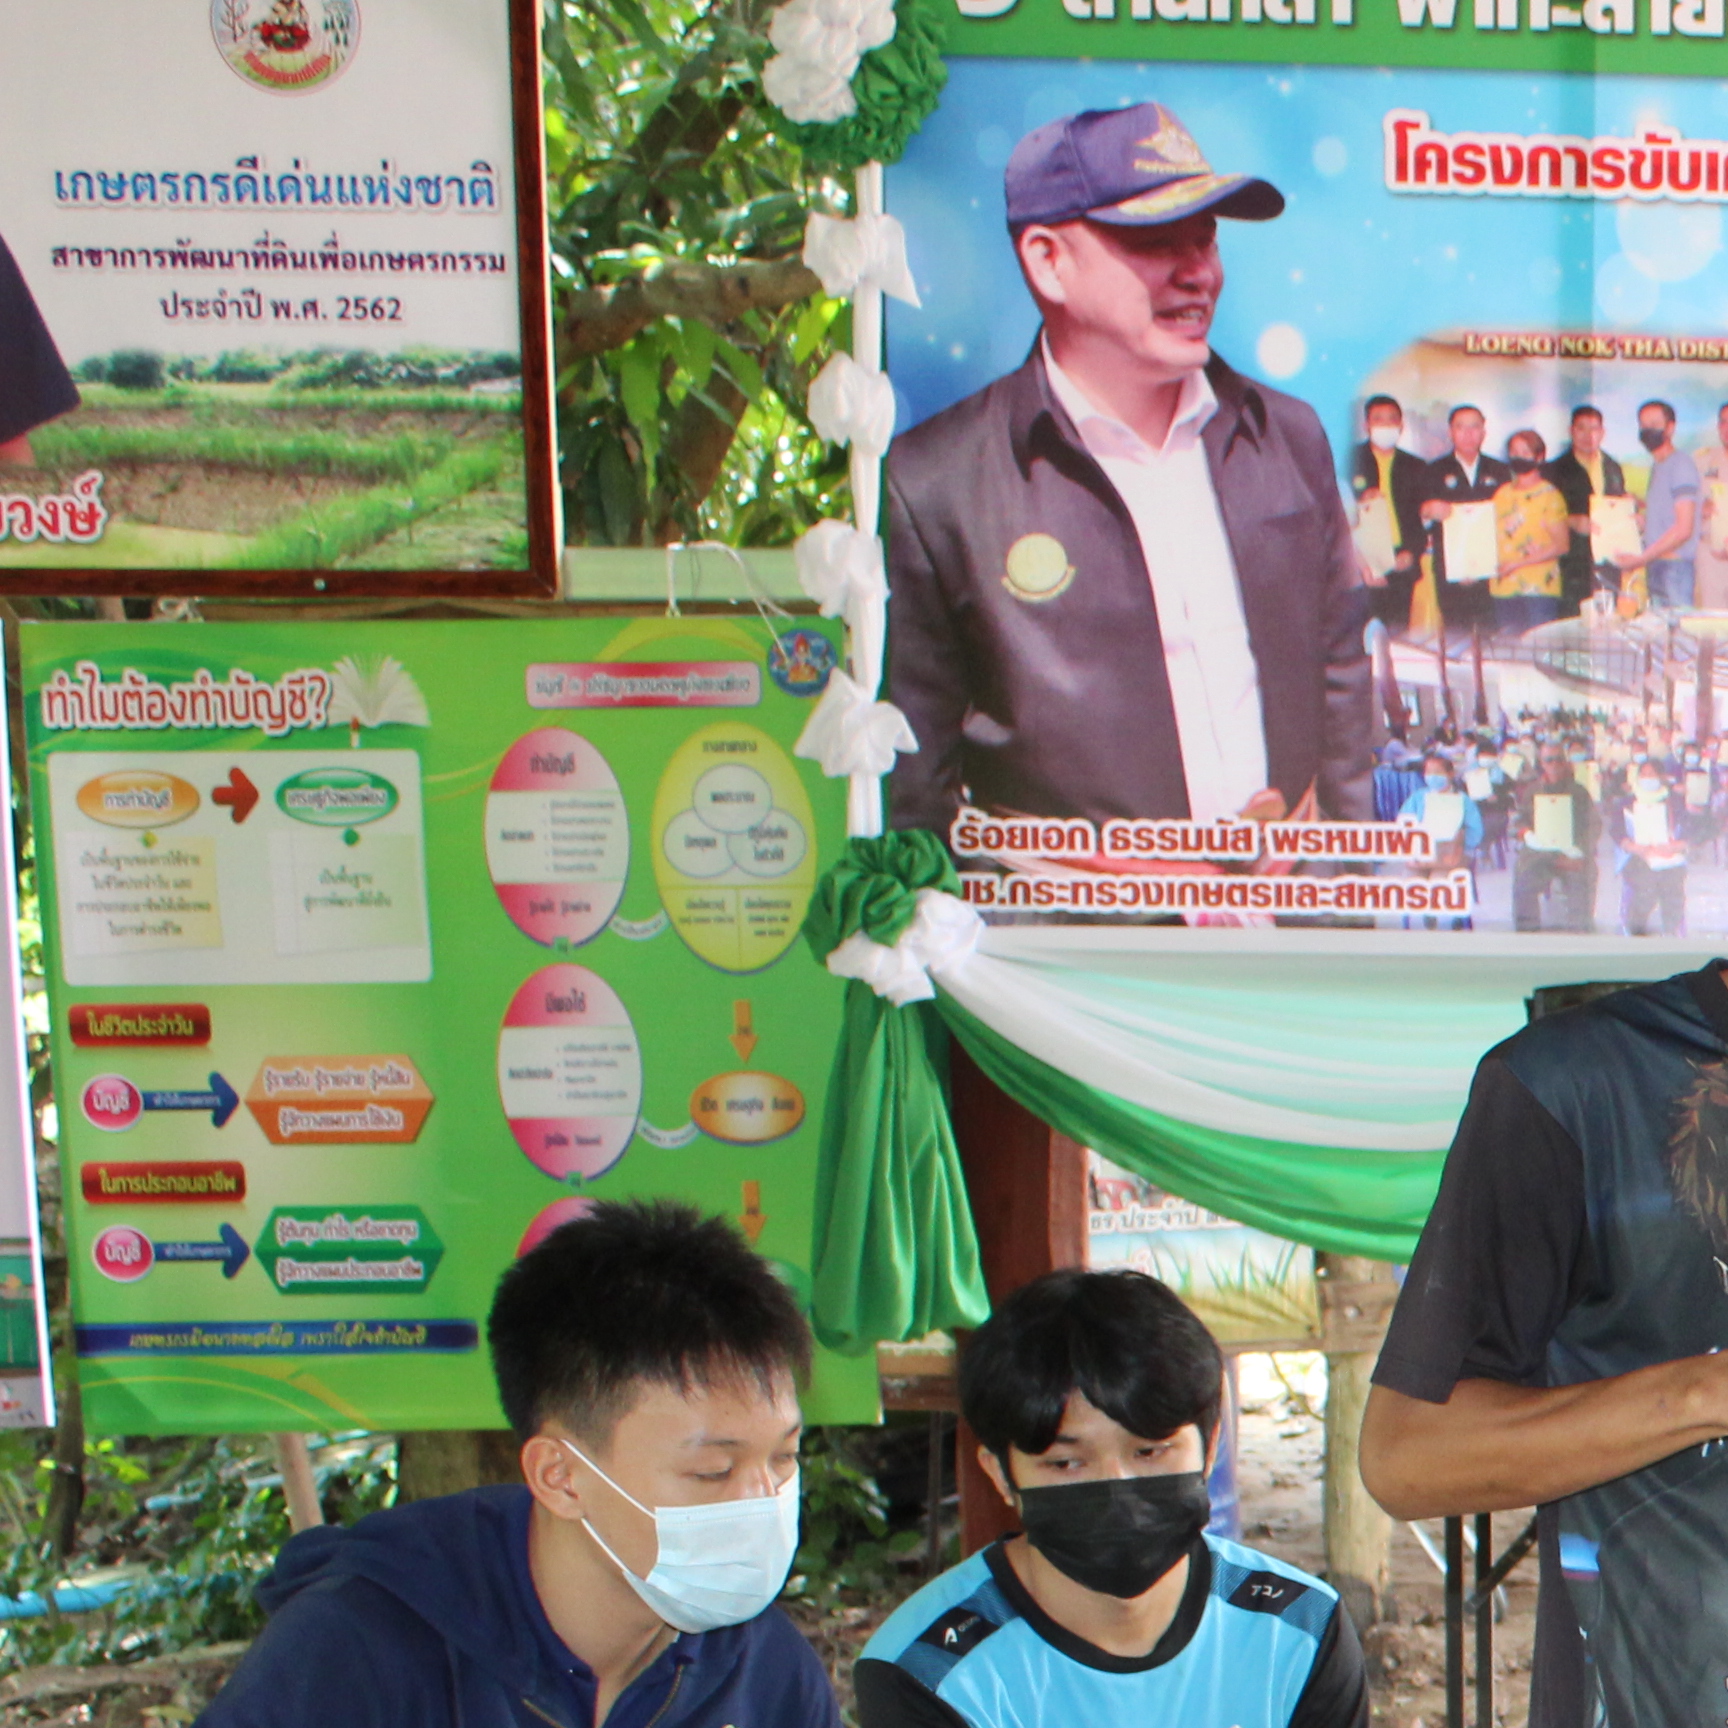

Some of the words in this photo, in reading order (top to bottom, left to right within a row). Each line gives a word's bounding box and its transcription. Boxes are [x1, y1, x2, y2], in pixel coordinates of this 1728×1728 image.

[54, 156, 495, 206] เกษตรกรดีเด่นแห่งชาติ
[51, 230, 505, 272] สาขาการพัฒนาที่ดินเพื่อเกษตรกรรม
[160, 288, 262, 320] ประจำปี
[271, 299, 328, 320] พ.ศ.
[337, 297, 402, 320] 2562
[1560, 335, 1615, 359] NOK
[1621, 337, 1674, 360] THA
[0, 472, 101, 538] วงษ์
[46, 669, 328, 731] ทำไมต้องทำบัญชี?
[959, 814, 1089, 853] ร้อยเอก
[1110, 820, 1253, 855] ธรรมนัส
[1271, 819, 1430, 857] พรหมเผ่า
[962, 876, 1467, 911] มช.กระทรวงเกษตรและสหกรณ์
